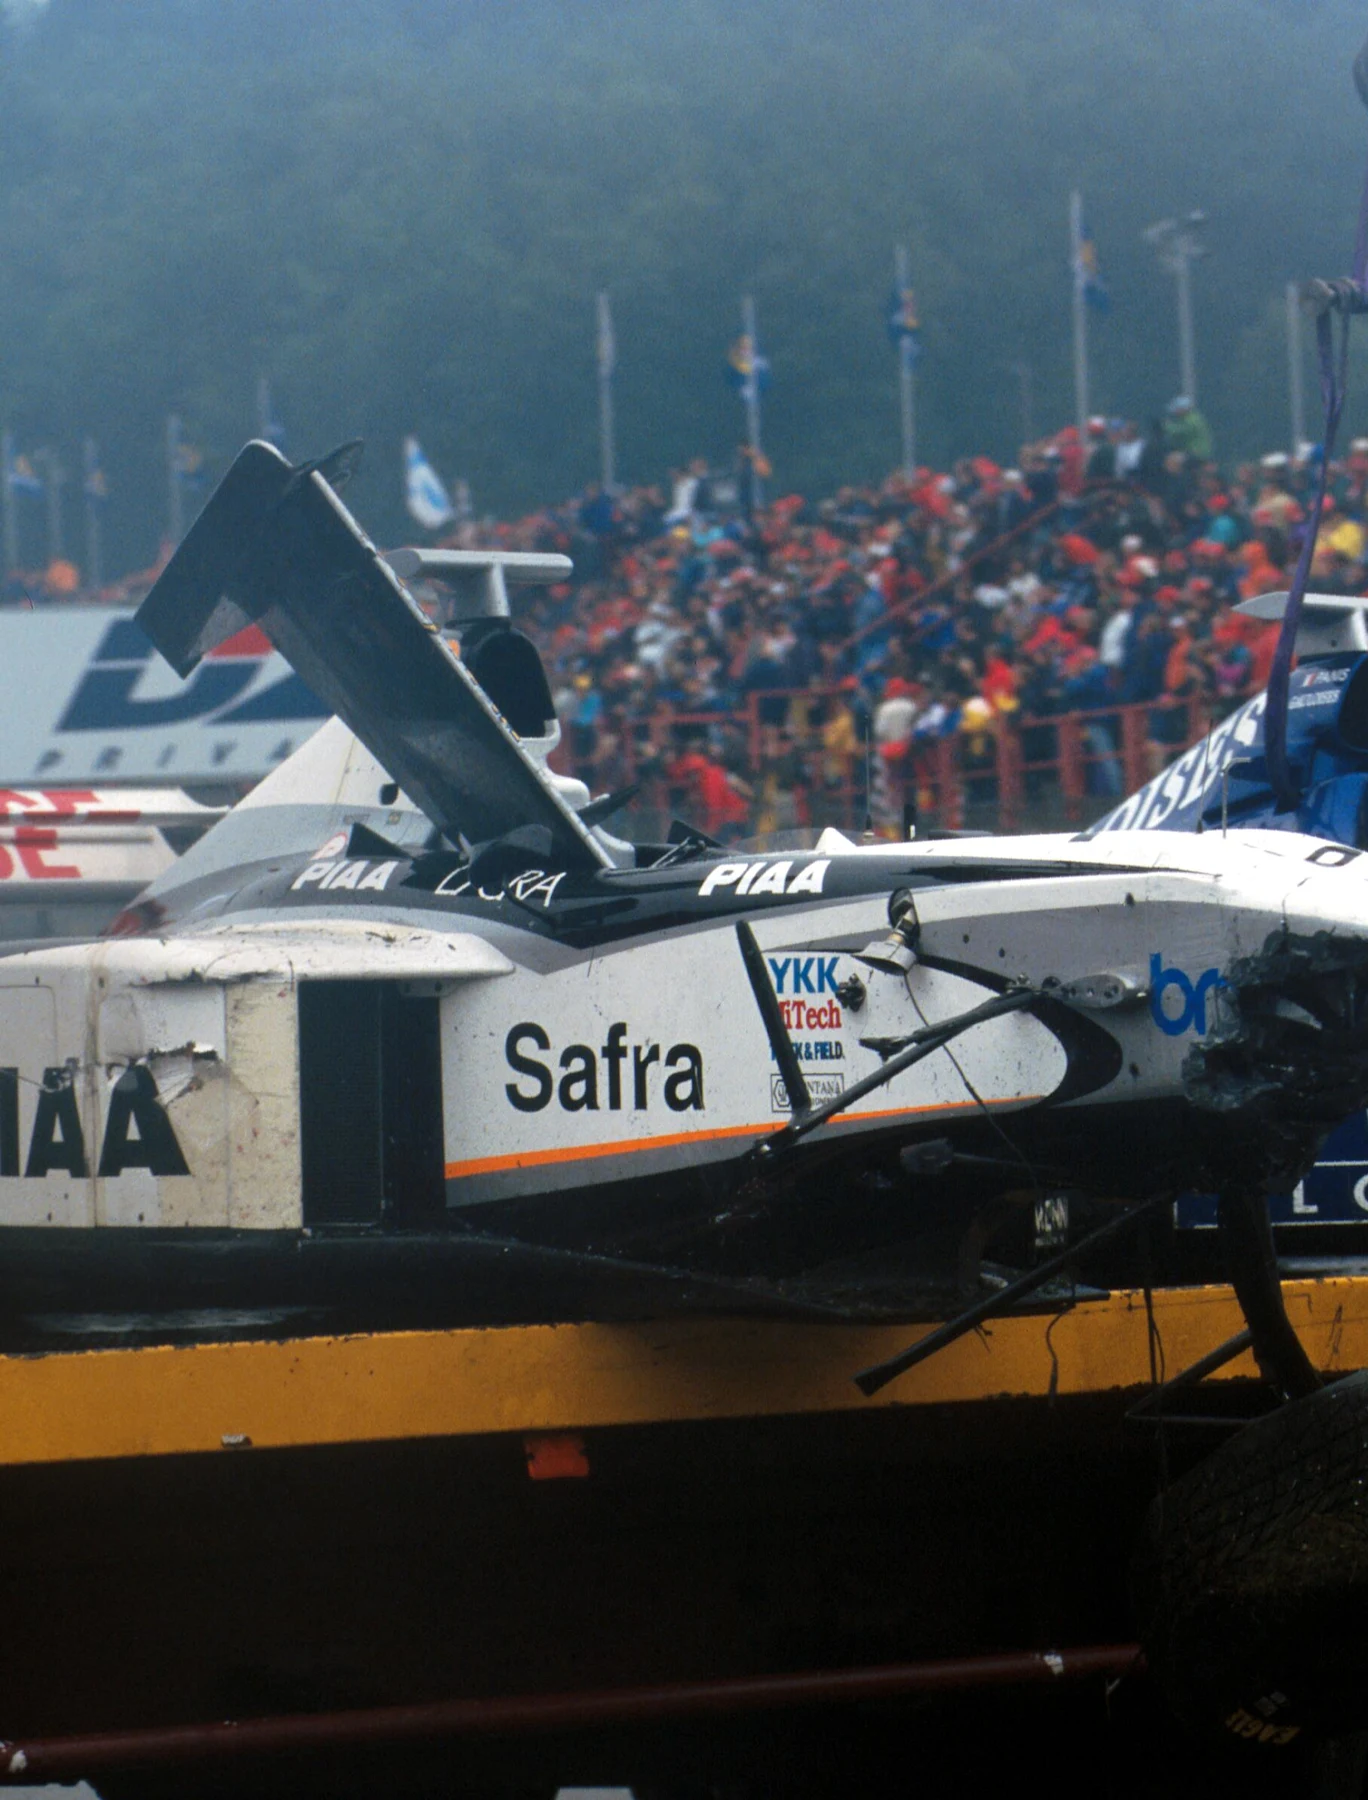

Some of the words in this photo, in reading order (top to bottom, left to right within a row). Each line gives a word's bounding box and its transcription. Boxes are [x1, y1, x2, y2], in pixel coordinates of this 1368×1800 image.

[290, 860, 400, 892] PIAA
[698, 860, 831, 896] PIAA
[768, 957, 841, 994] YKK
[504, 1022, 704, 1112] Safra
